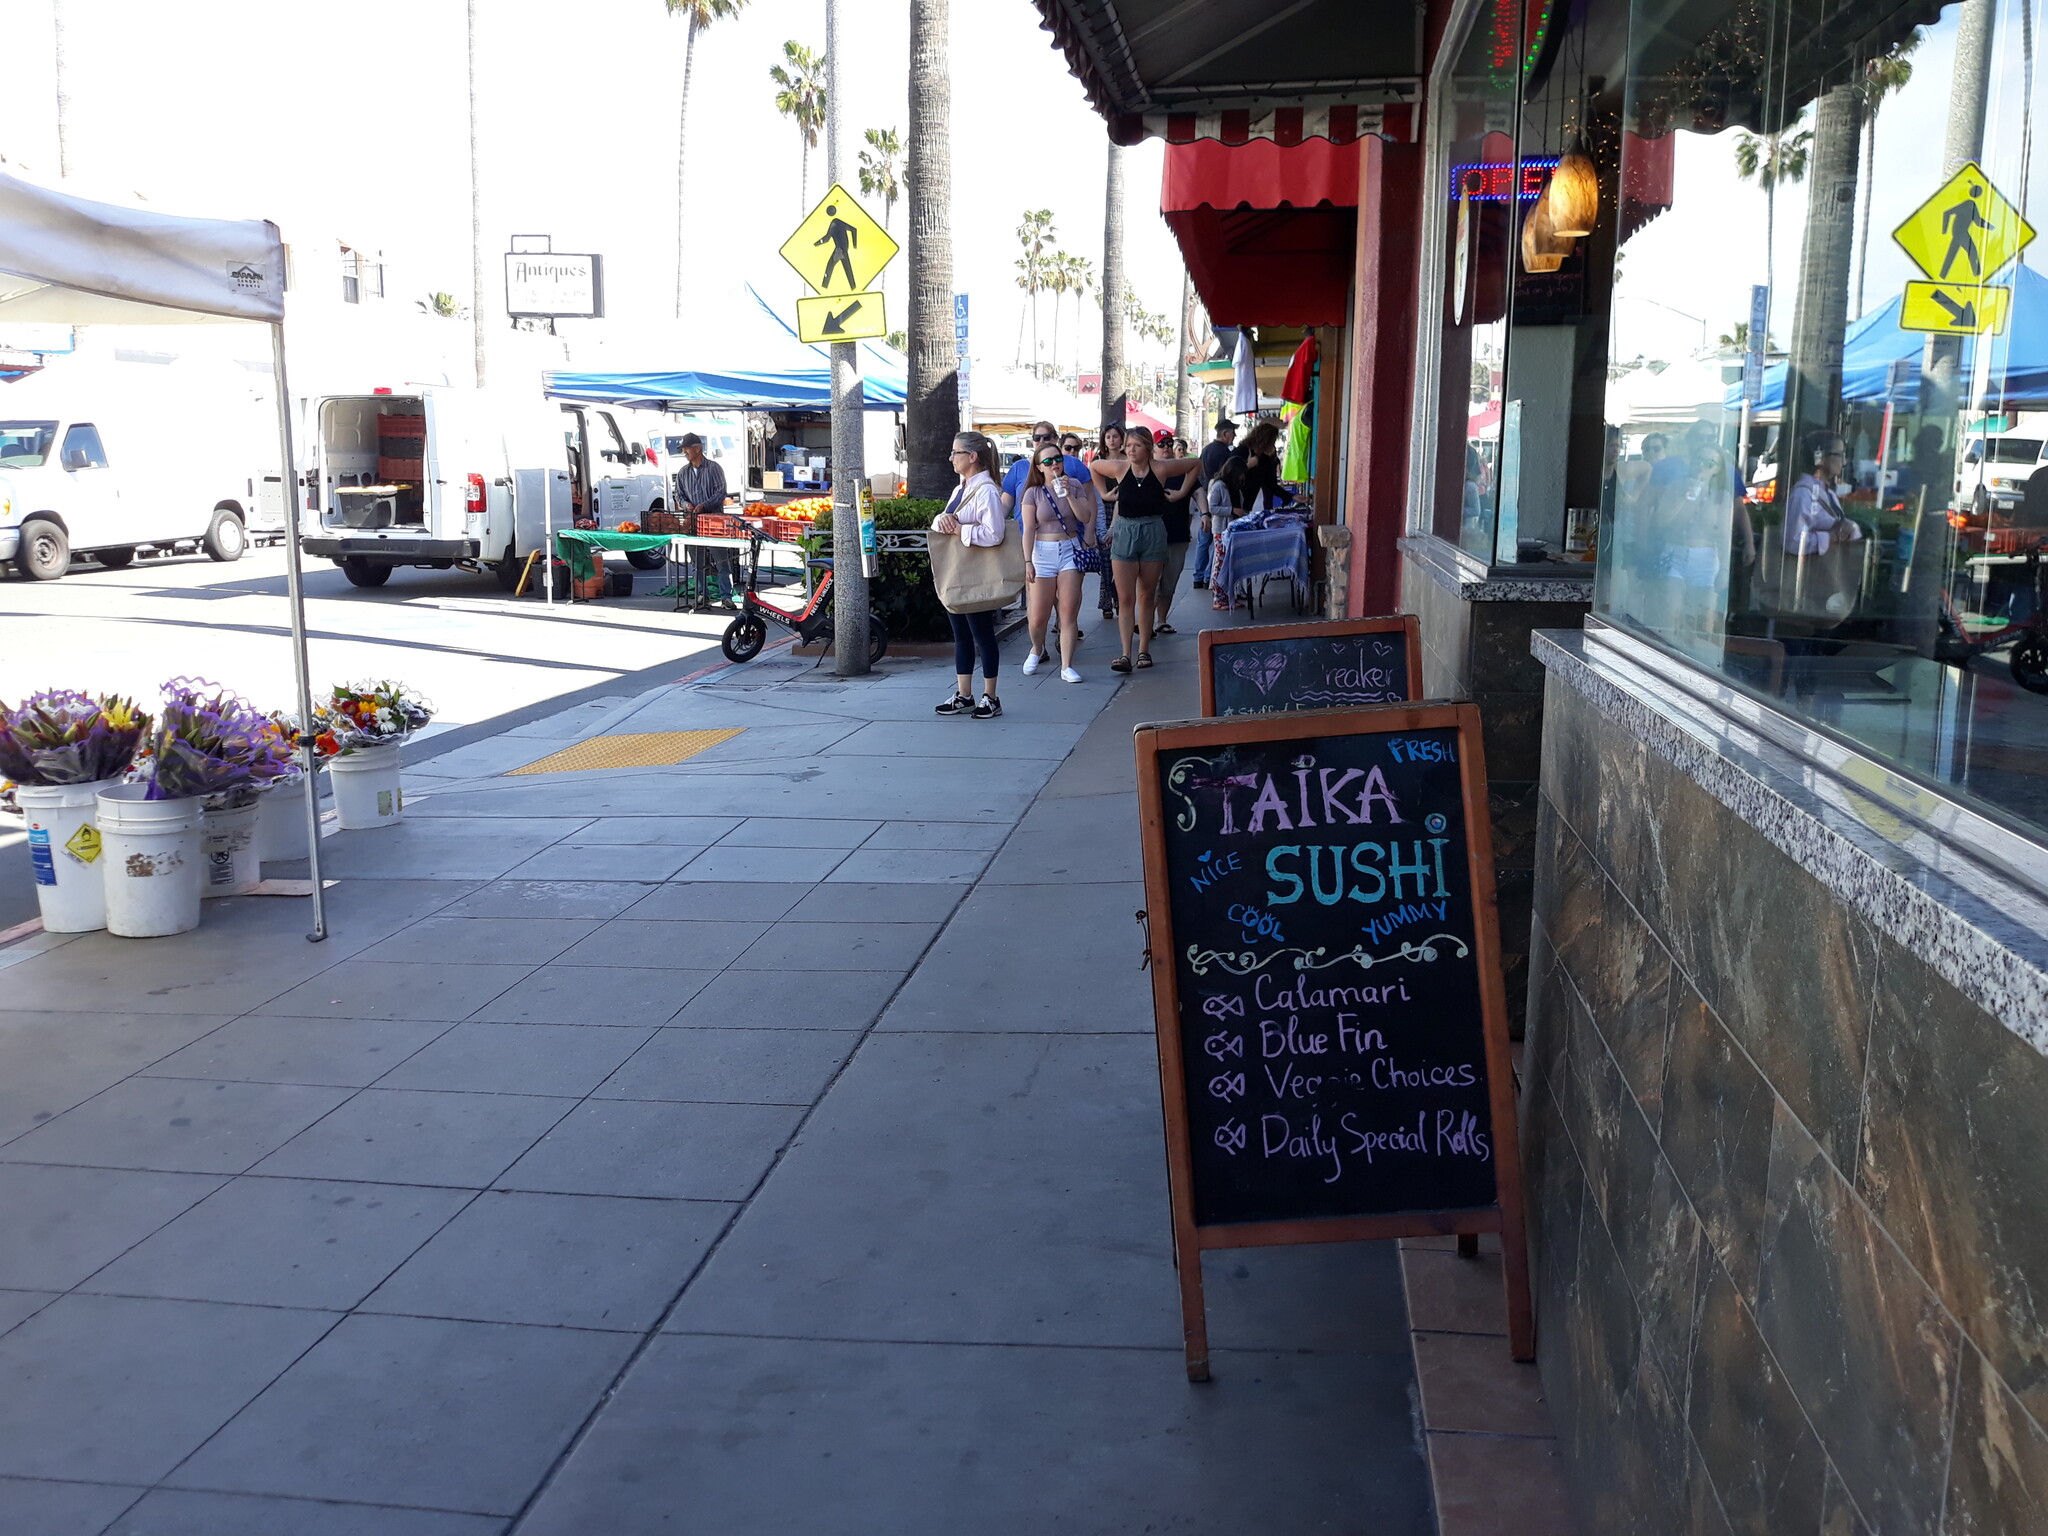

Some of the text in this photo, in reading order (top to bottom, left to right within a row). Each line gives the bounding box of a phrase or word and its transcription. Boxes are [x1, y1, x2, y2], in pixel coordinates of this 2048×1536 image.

[515, 262, 586, 283] Antiques
[760, 606, 790, 624] WHEELS
[1387, 737, 1455, 763] FRESH
[1191, 755, 1404, 834] TAIKA
[1190, 852, 1243, 893] NICE
[1265, 813, 1452, 907] SUSHI
[1227, 904, 1285, 942] COOL
[1362, 900, 1446, 944] YUMMY
[1255, 973, 1411, 1011] Calamari
[1259, 1012, 1388, 1058] Blue Fin
[1372, 1057, 1475, 1089] Choices
[1261, 1109, 1489, 1183] Daily Special Rolls
